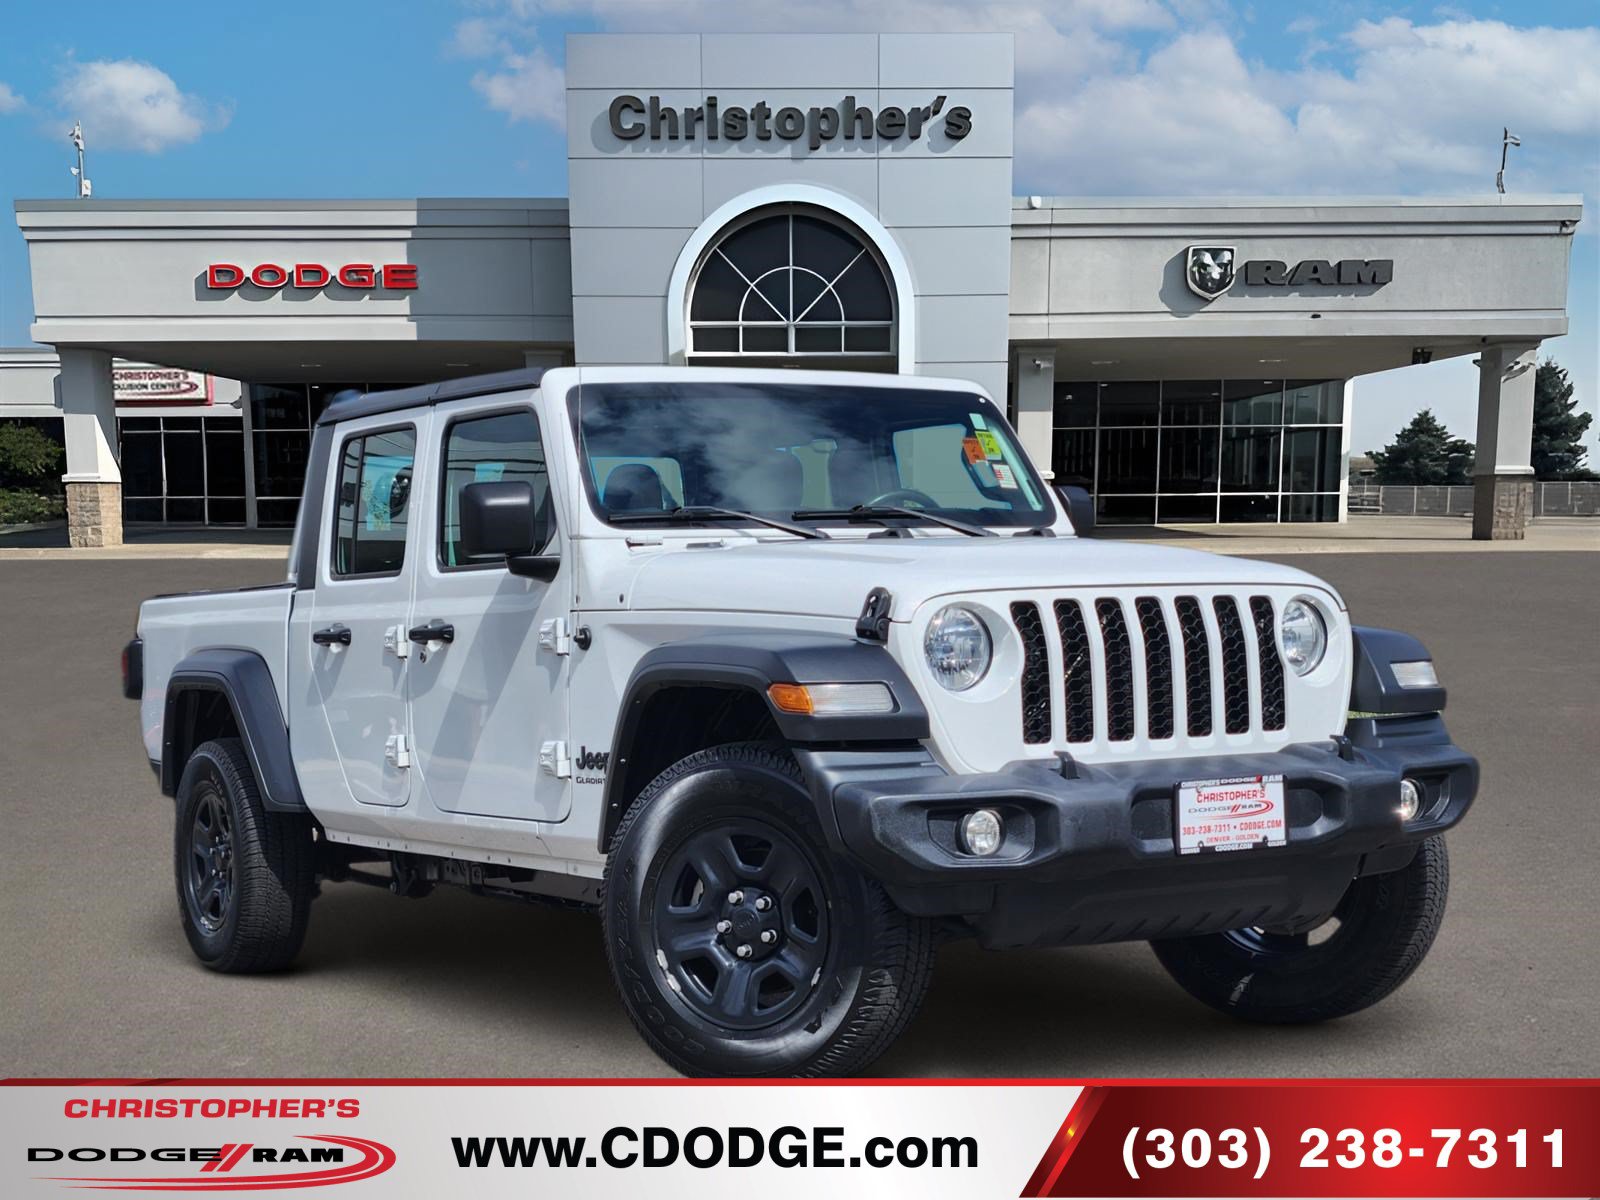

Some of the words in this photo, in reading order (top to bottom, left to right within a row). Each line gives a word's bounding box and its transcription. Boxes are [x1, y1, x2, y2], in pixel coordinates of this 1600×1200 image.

[609, 95, 972, 150] Christopher's
[207, 263, 417, 288] DODGE
[1245, 260, 1393, 285] RAM
[1197, 789, 1266, 804] CHRISTOPHER'S
[1182, 824, 1231, 836] 303-238-7311
[1239, 819, 1282, 831] CDODGE.COM
